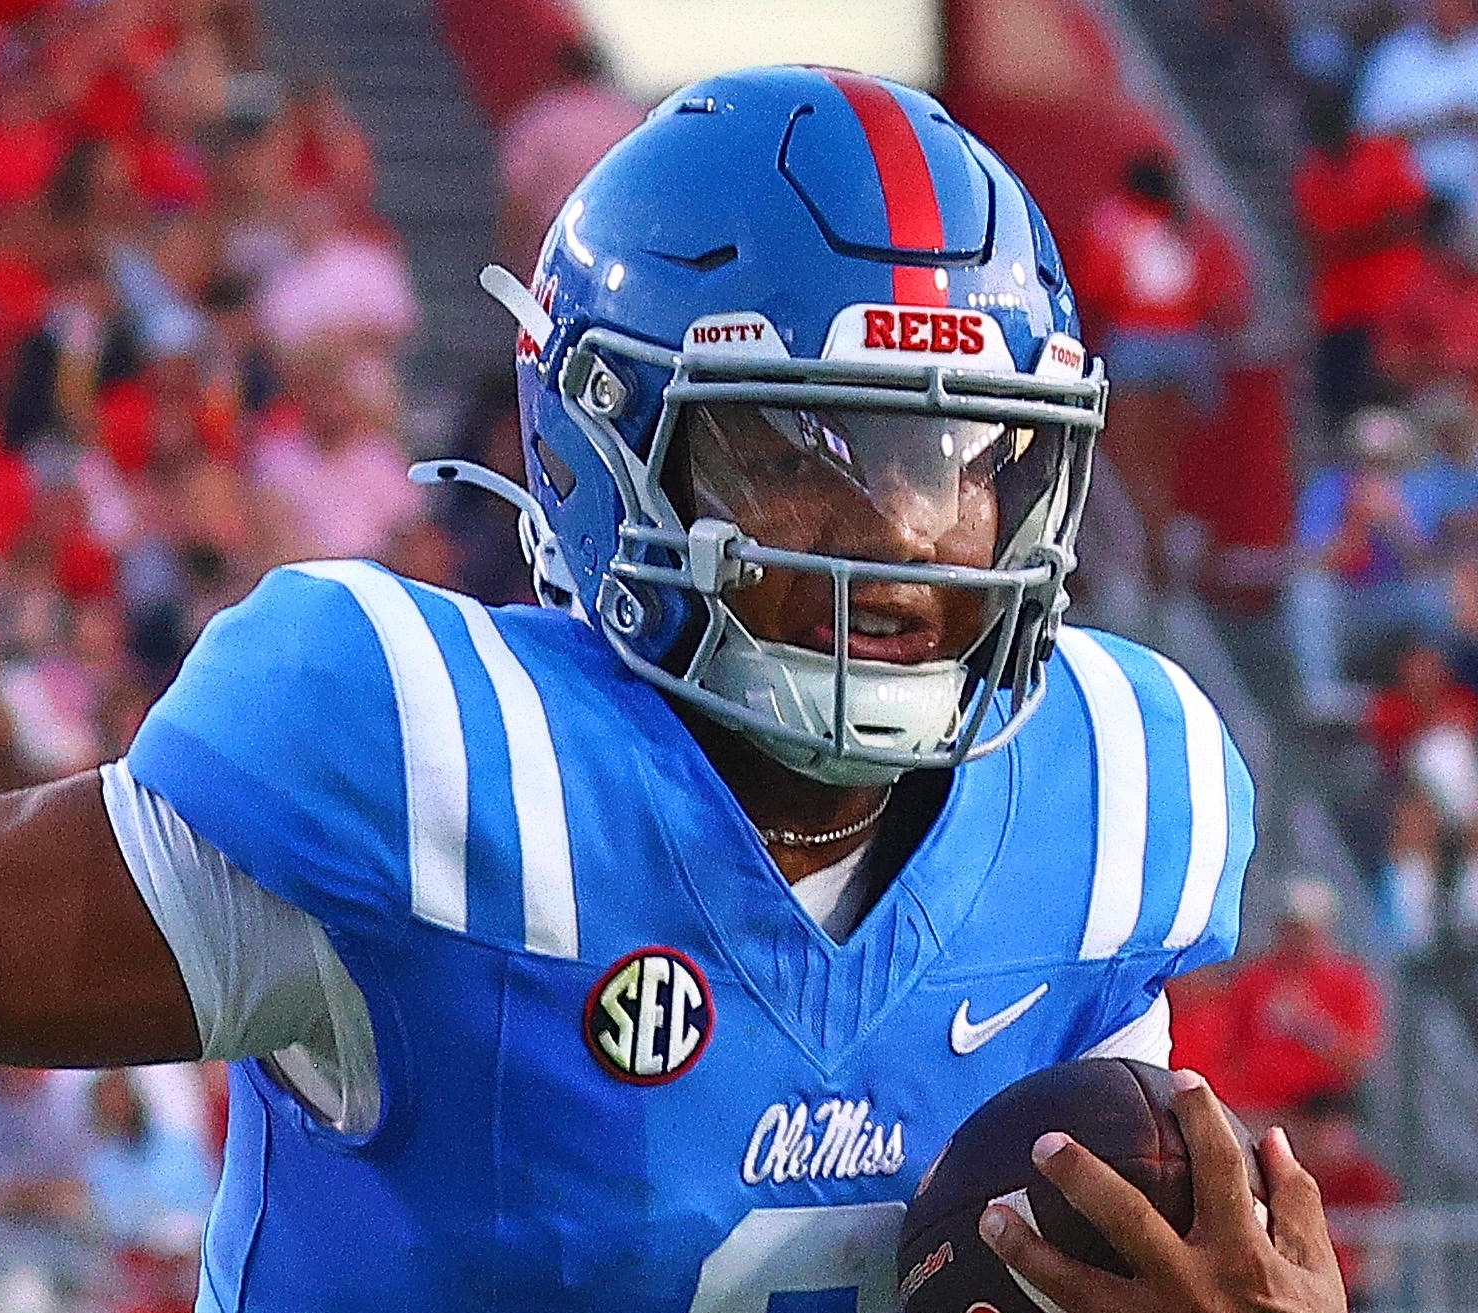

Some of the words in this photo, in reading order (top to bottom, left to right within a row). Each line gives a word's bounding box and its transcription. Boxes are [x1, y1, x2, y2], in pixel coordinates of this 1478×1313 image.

[692, 322, 766, 344] HOTTY
[864, 308, 984, 355] REBS
[598, 956, 702, 1076] SEC
[743, 1102, 814, 1184] Ole
[809, 1098, 906, 1180] Miss
